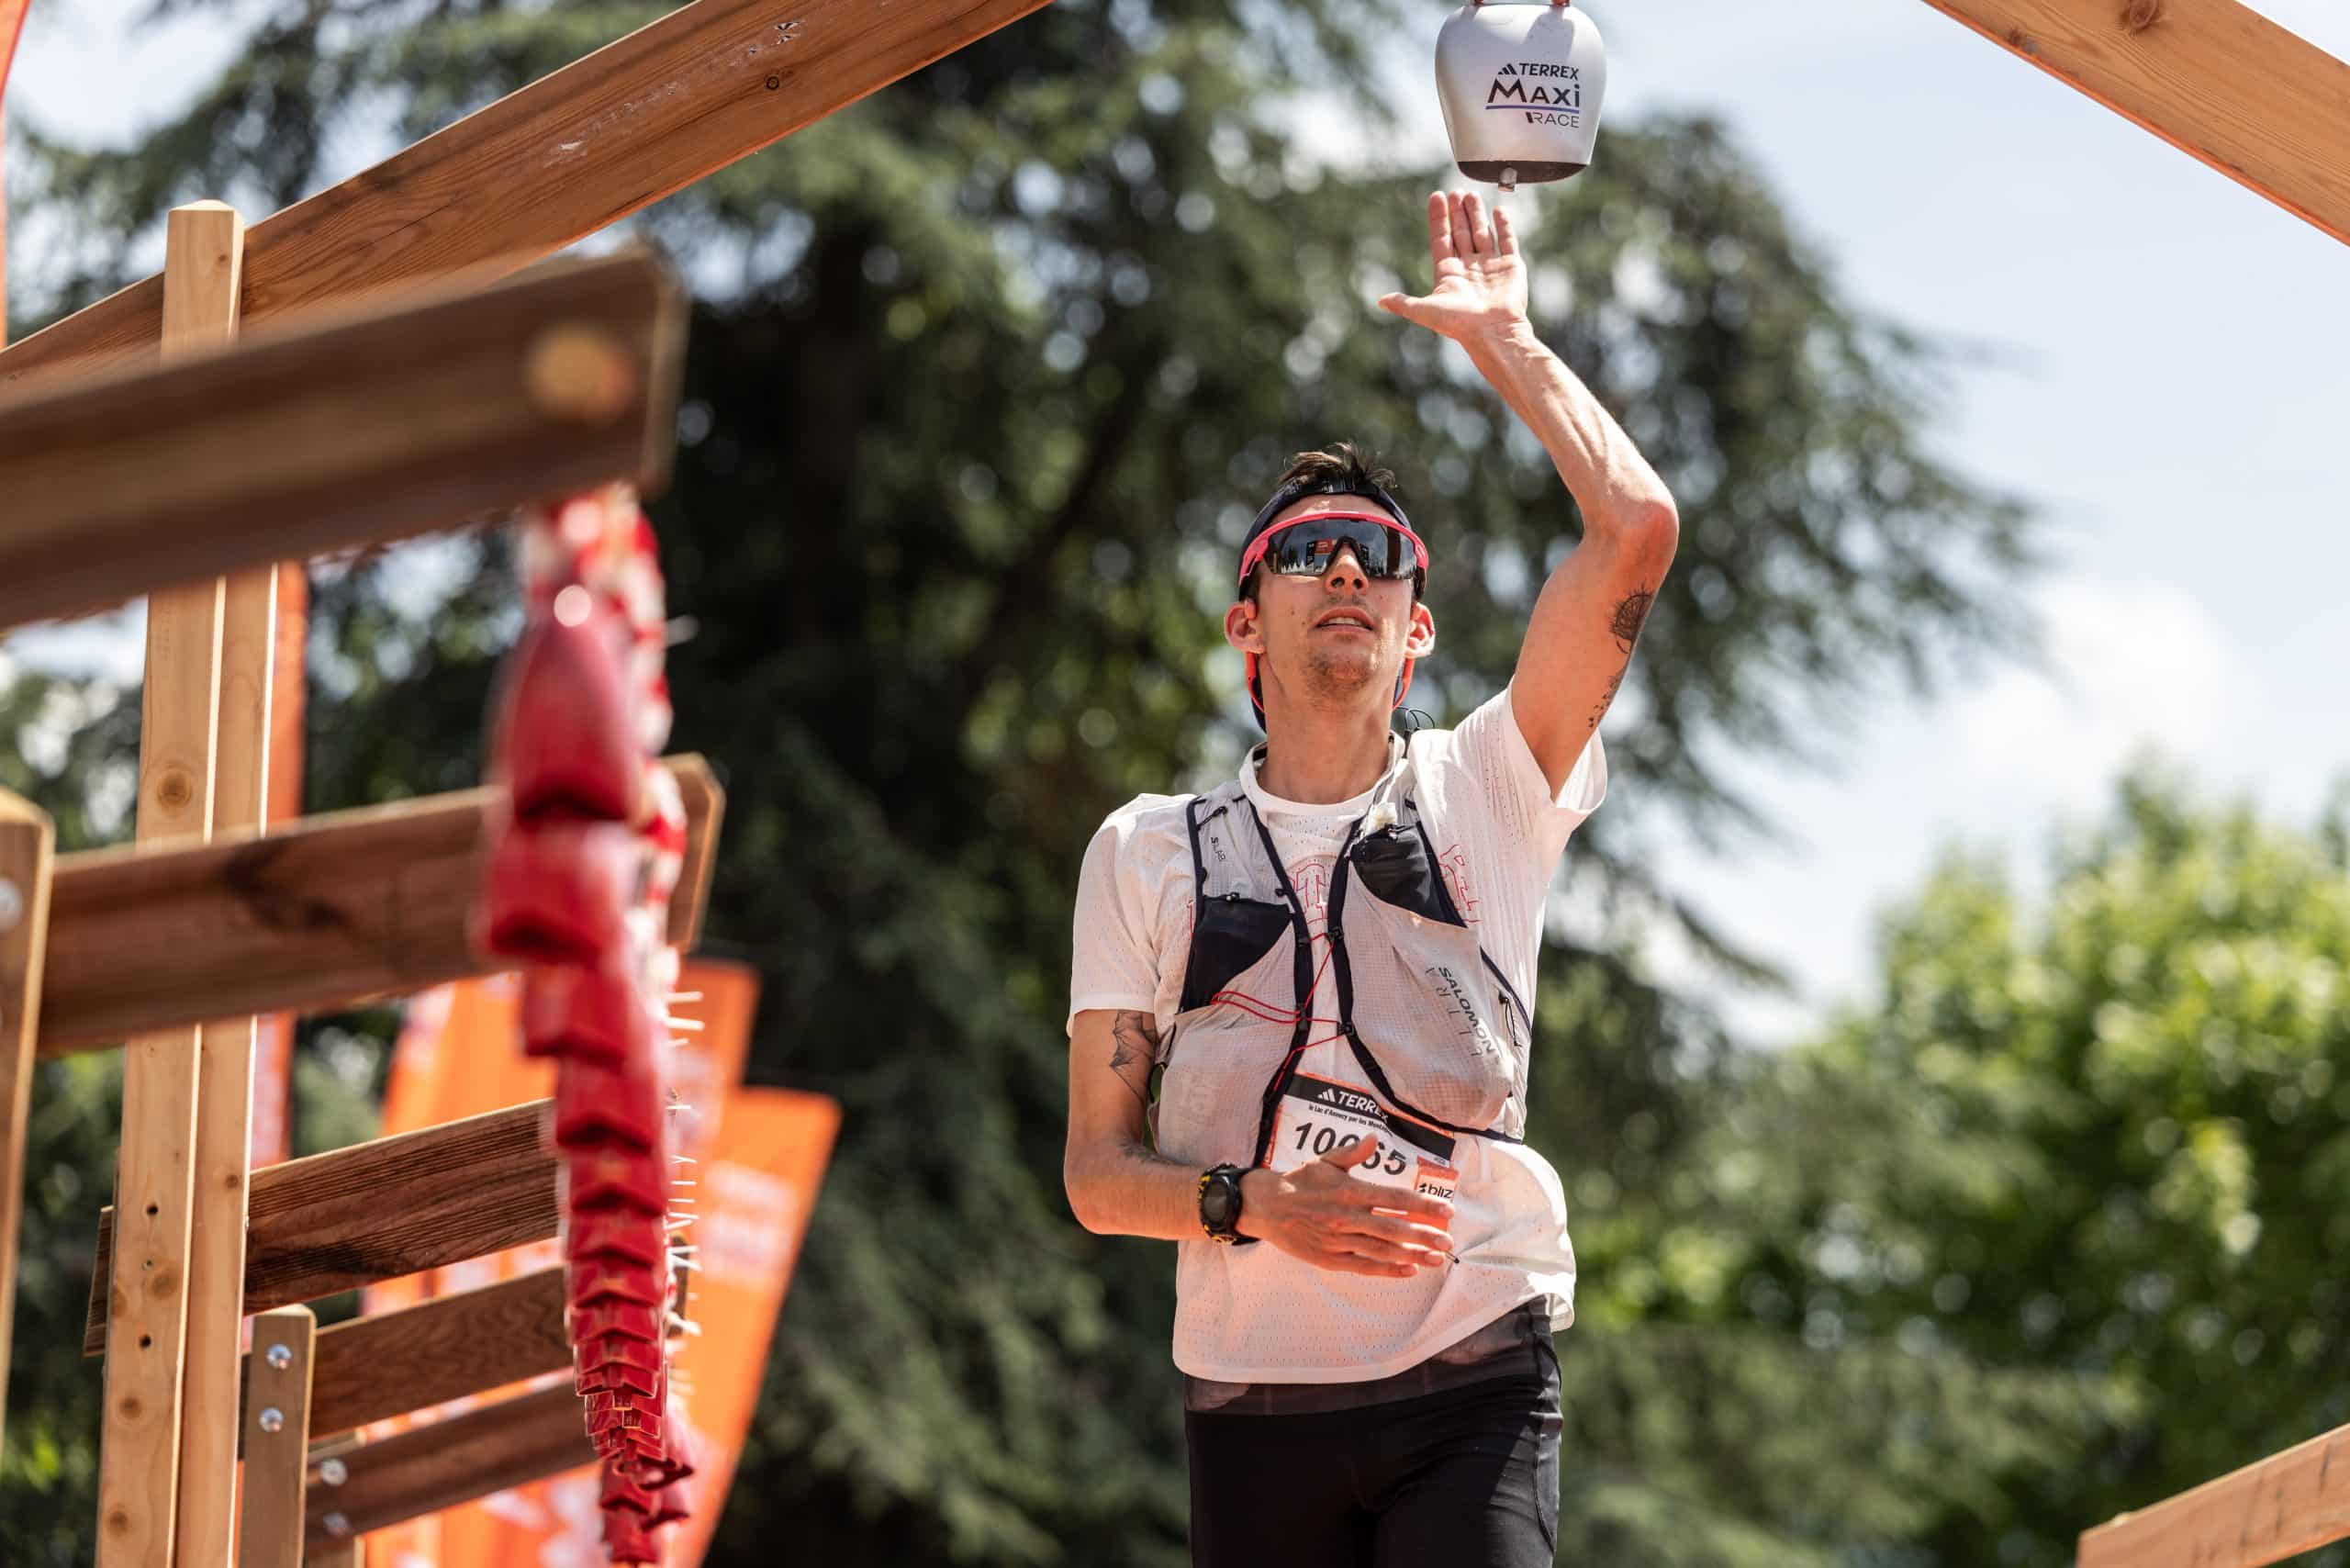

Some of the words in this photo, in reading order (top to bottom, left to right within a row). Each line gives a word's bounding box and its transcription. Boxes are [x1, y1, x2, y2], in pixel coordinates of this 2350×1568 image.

[1518, 62, 1579, 81] TERREX
[1526, 111, 1580, 129] RACE
[1438, 967, 1495, 1053] SALOMON
[1427, 1183, 1453, 1199] bliz
